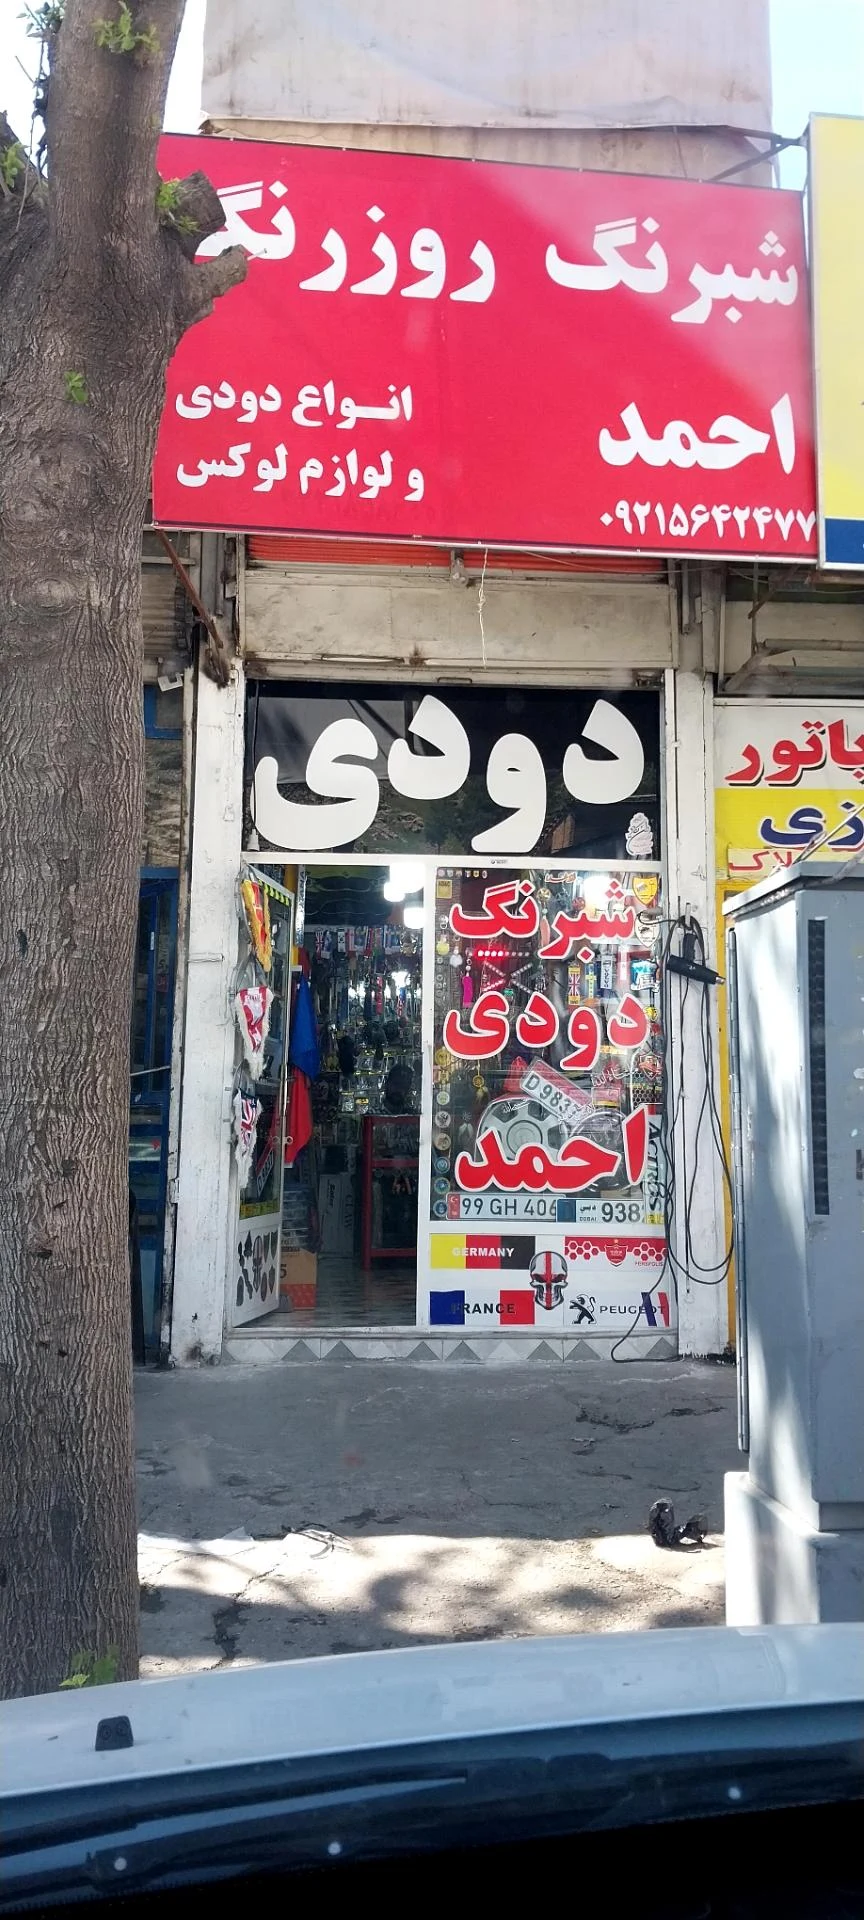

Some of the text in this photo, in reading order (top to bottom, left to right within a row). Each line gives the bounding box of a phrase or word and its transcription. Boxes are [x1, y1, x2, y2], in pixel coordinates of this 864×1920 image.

[545, 216, 798, 324] شبرنگ
[175, 379, 413, 430] انواع دودی
[599, 393, 797, 474] احمد
[299, 448, 394, 499] لوازم
[403, 467, 425, 502] و
[600, 499, 816, 542] ۰۹۲۱۵۶۴۲۴۷۷
[253, 694, 645, 853] دودی
[449, 879, 637, 963] شبرنگ
[443, 990, 650, 1071] دودی
[454, 1102, 649, 1193] احمد
[462, 1198, 484, 1216] 99
[489, 1198, 517, 1216] GH
[452, 1247, 515, 1258] GERMANY
[450, 1302, 516, 1315] FRANCE
[599, 1304, 665, 1315] PEUGEOT
